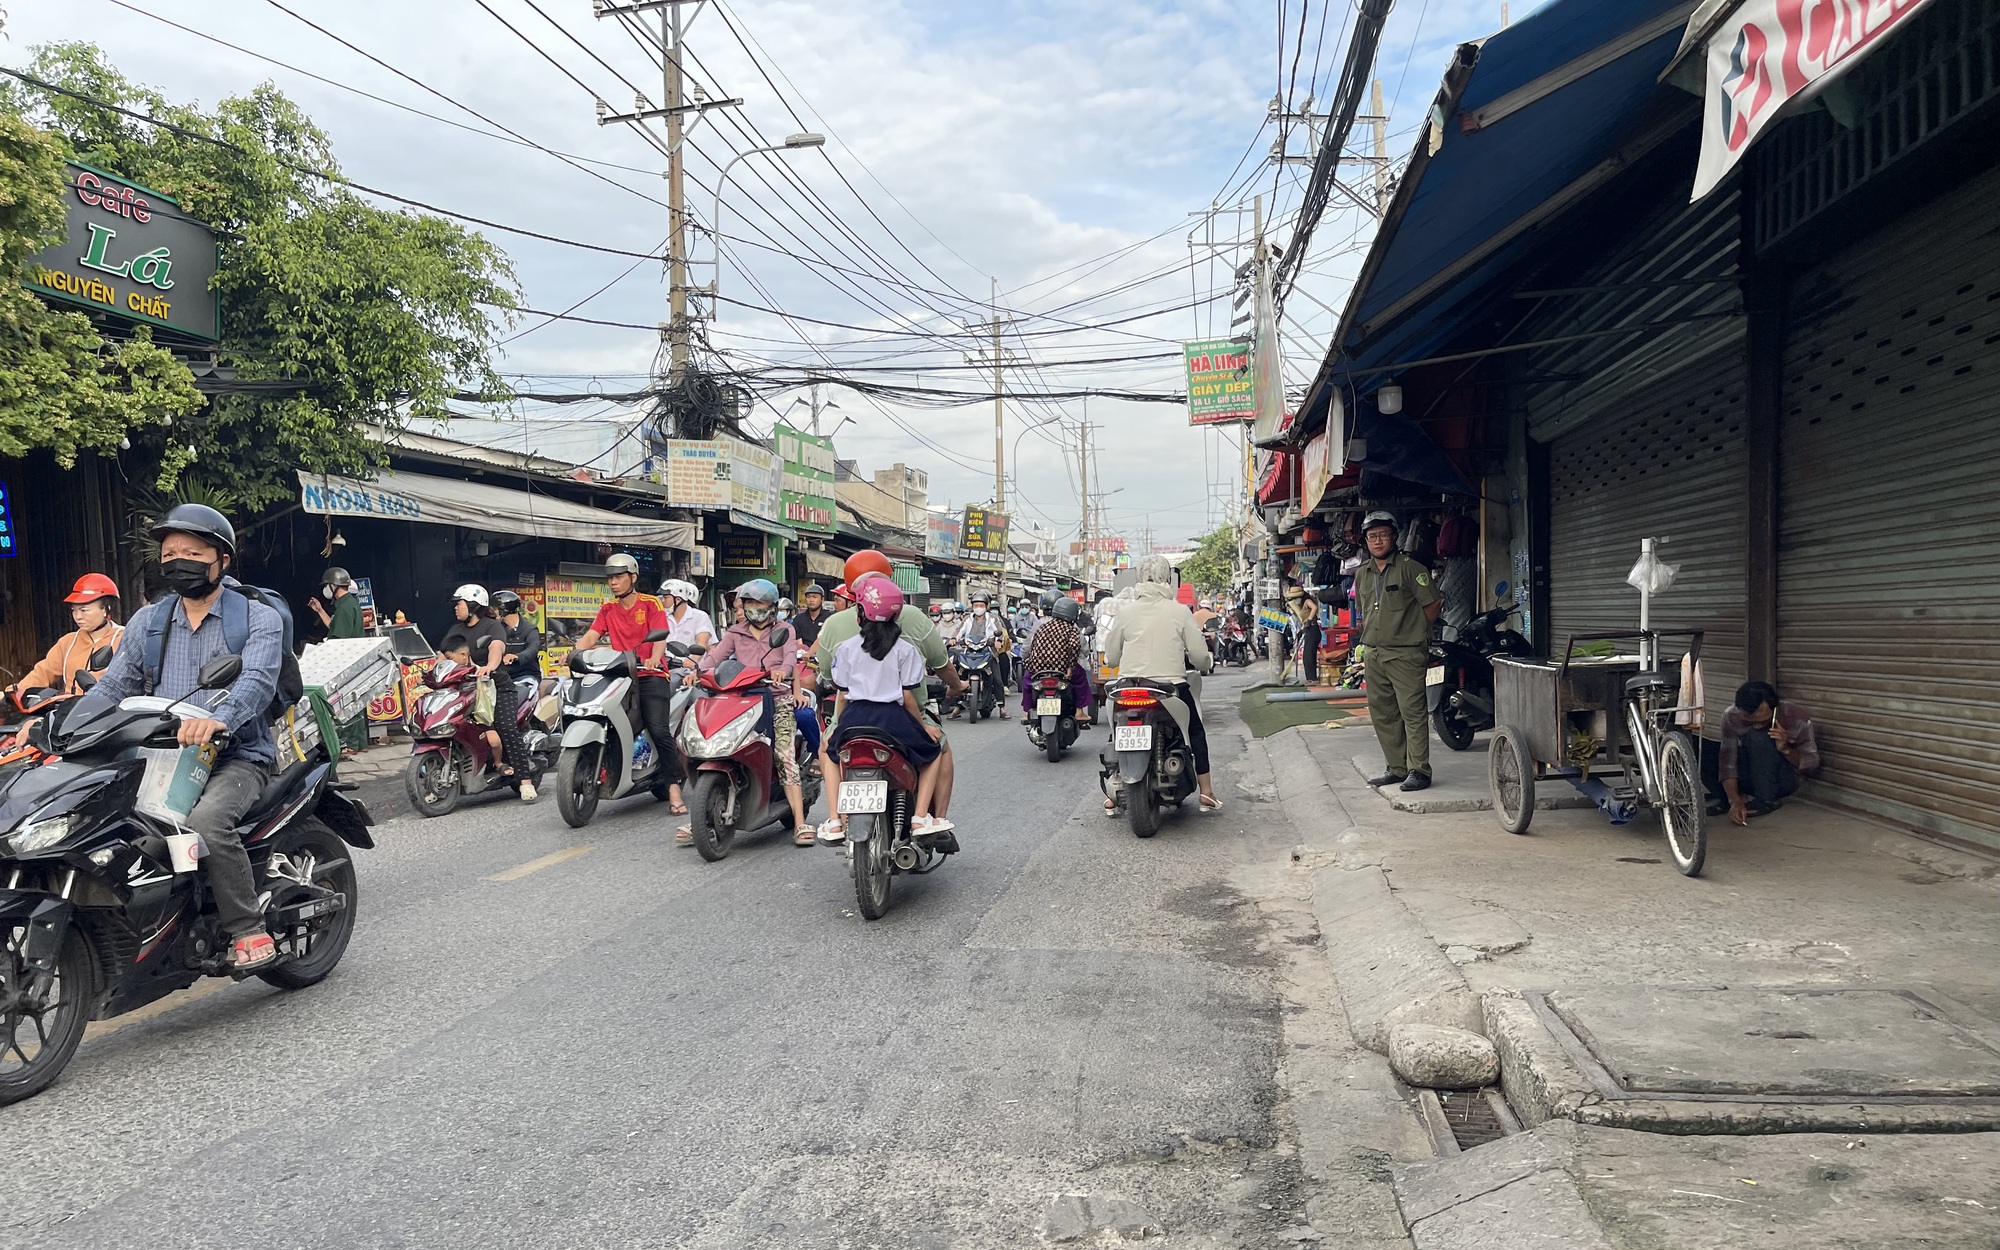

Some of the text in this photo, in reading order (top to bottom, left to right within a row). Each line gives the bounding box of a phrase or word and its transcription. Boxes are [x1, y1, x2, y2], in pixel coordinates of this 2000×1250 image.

[77, 172, 151, 223] Cafe
[80, 222, 175, 290] Lá
[38, 270, 171, 320] NGUYÊN CHẤT
[1190, 352, 1248, 372] HÀ LINH
[1192, 384, 1221, 396] GIÀY
[724, 538, 760, 547] PHOTOCOPY
[370, 686, 397, 715] SỐ
[1121, 728, 1146, 738] 50-AA
[1118, 738, 1149, 749] 639.52
[846, 784, 879, 797] 66-P1
[841, 798, 883, 811] 894.28
